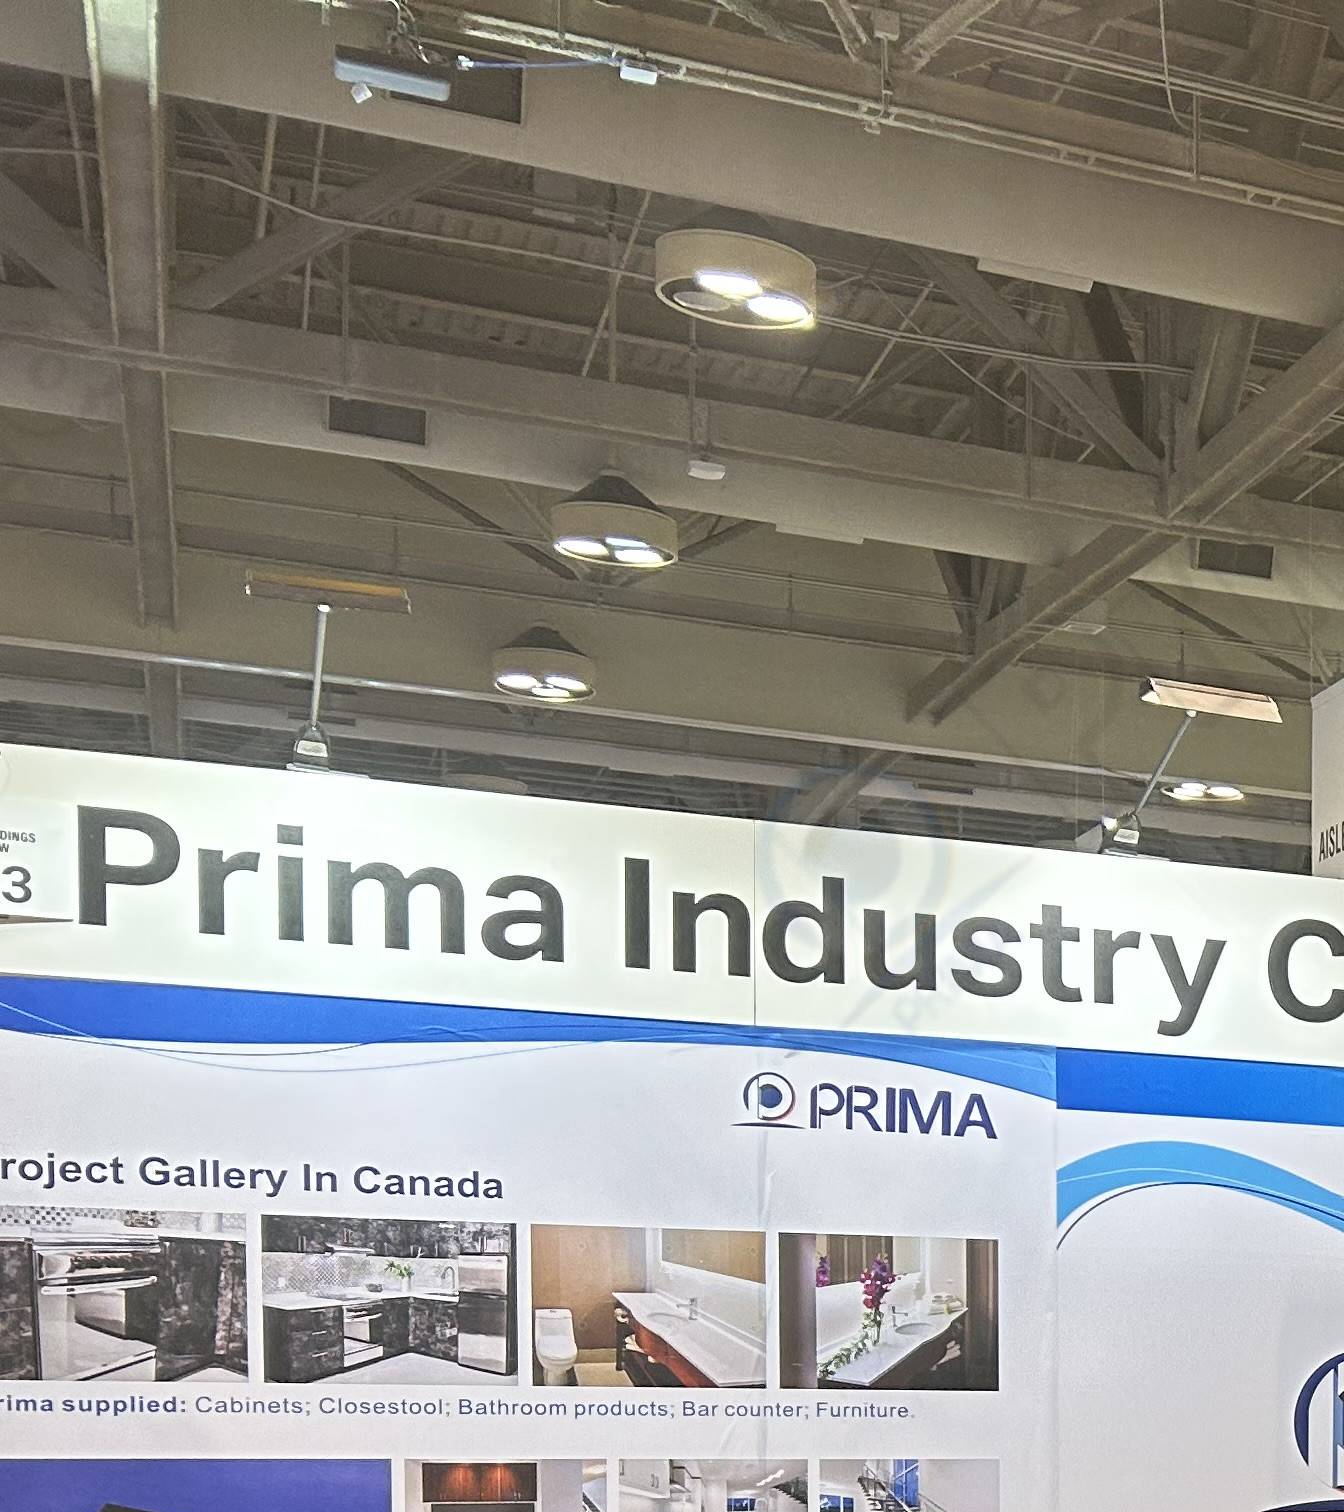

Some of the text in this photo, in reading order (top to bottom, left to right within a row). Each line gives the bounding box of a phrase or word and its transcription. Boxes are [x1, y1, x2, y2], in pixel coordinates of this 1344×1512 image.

[77, 805, 565, 963] Prima
[624, 857, 1228, 1037] Industry
[810, 1083, 998, 1140] PRIMA
[0, 1152, 504, 1199] roject Gallery In Canada
[62, 1395, 187, 1417] supplied:
[195, 1396, 311, 1416] Cabinets;
[319, 1397, 450, 1417] Closestool;
[458, 1398, 567, 1417] Bathroom
[574, 1400, 676, 1420] products;
[682, 1401, 717, 1417] Bar
[724, 1401, 809, 1419] counter;
[816, 1402, 916, 1419] Furniture.
